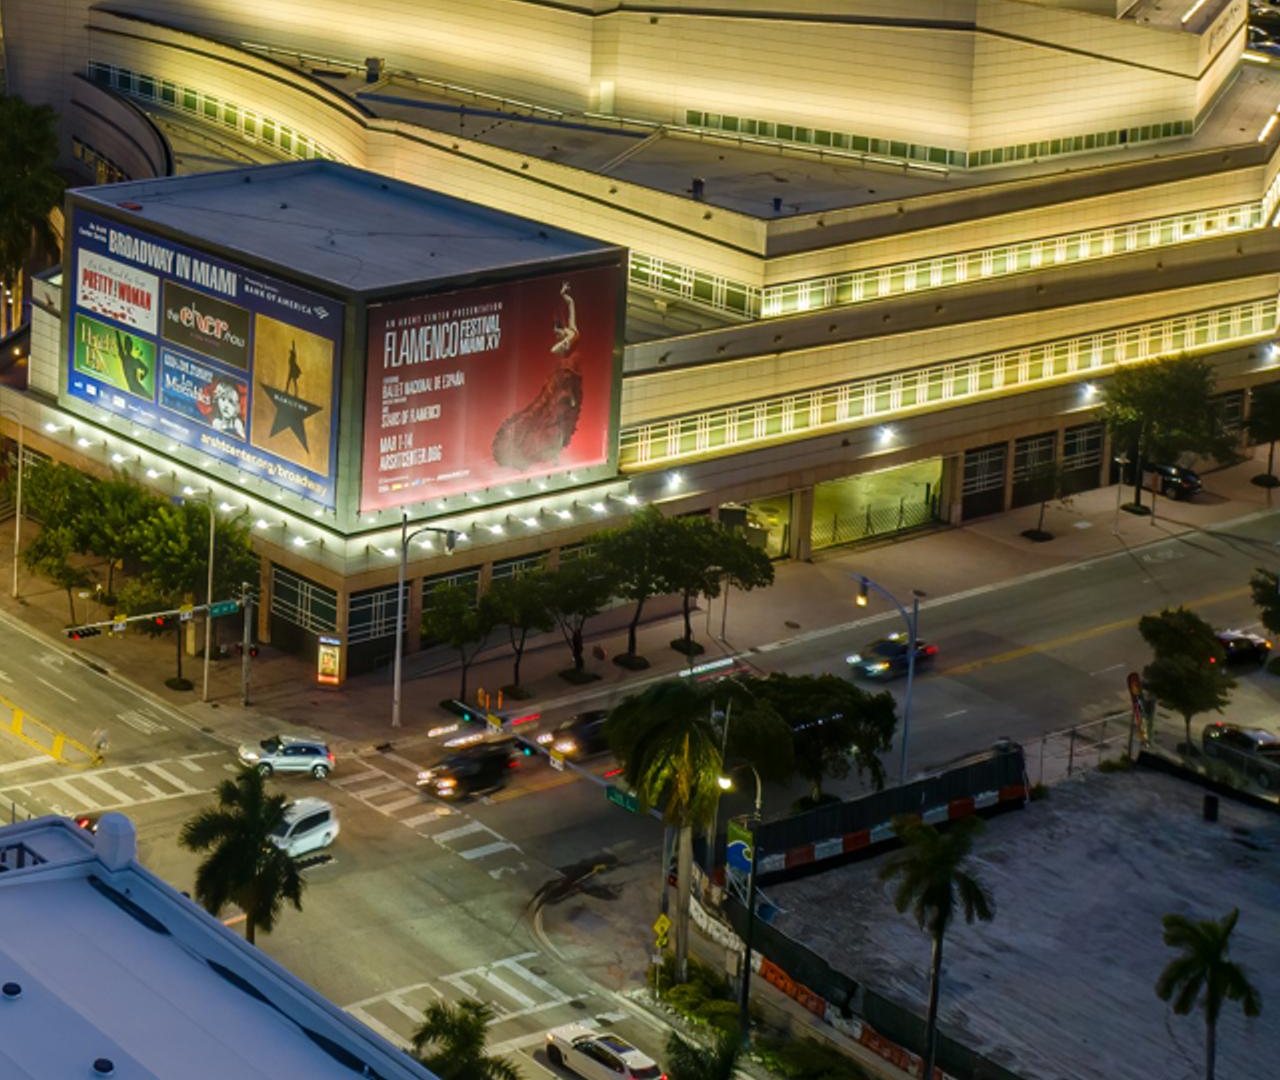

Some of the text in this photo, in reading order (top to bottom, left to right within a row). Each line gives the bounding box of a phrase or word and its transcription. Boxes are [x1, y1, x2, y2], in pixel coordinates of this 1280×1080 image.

[108, 229, 174, 274] BROADWAY
[175, 253, 191, 280] IN
[192, 258, 238, 298] MIAMI
[244, 284, 265, 299] BANK
[266, 291, 277, 303] OF
[278, 295, 313, 315] AMERICA
[383, 313, 501, 369] FLAMENCO FESTIVAL
